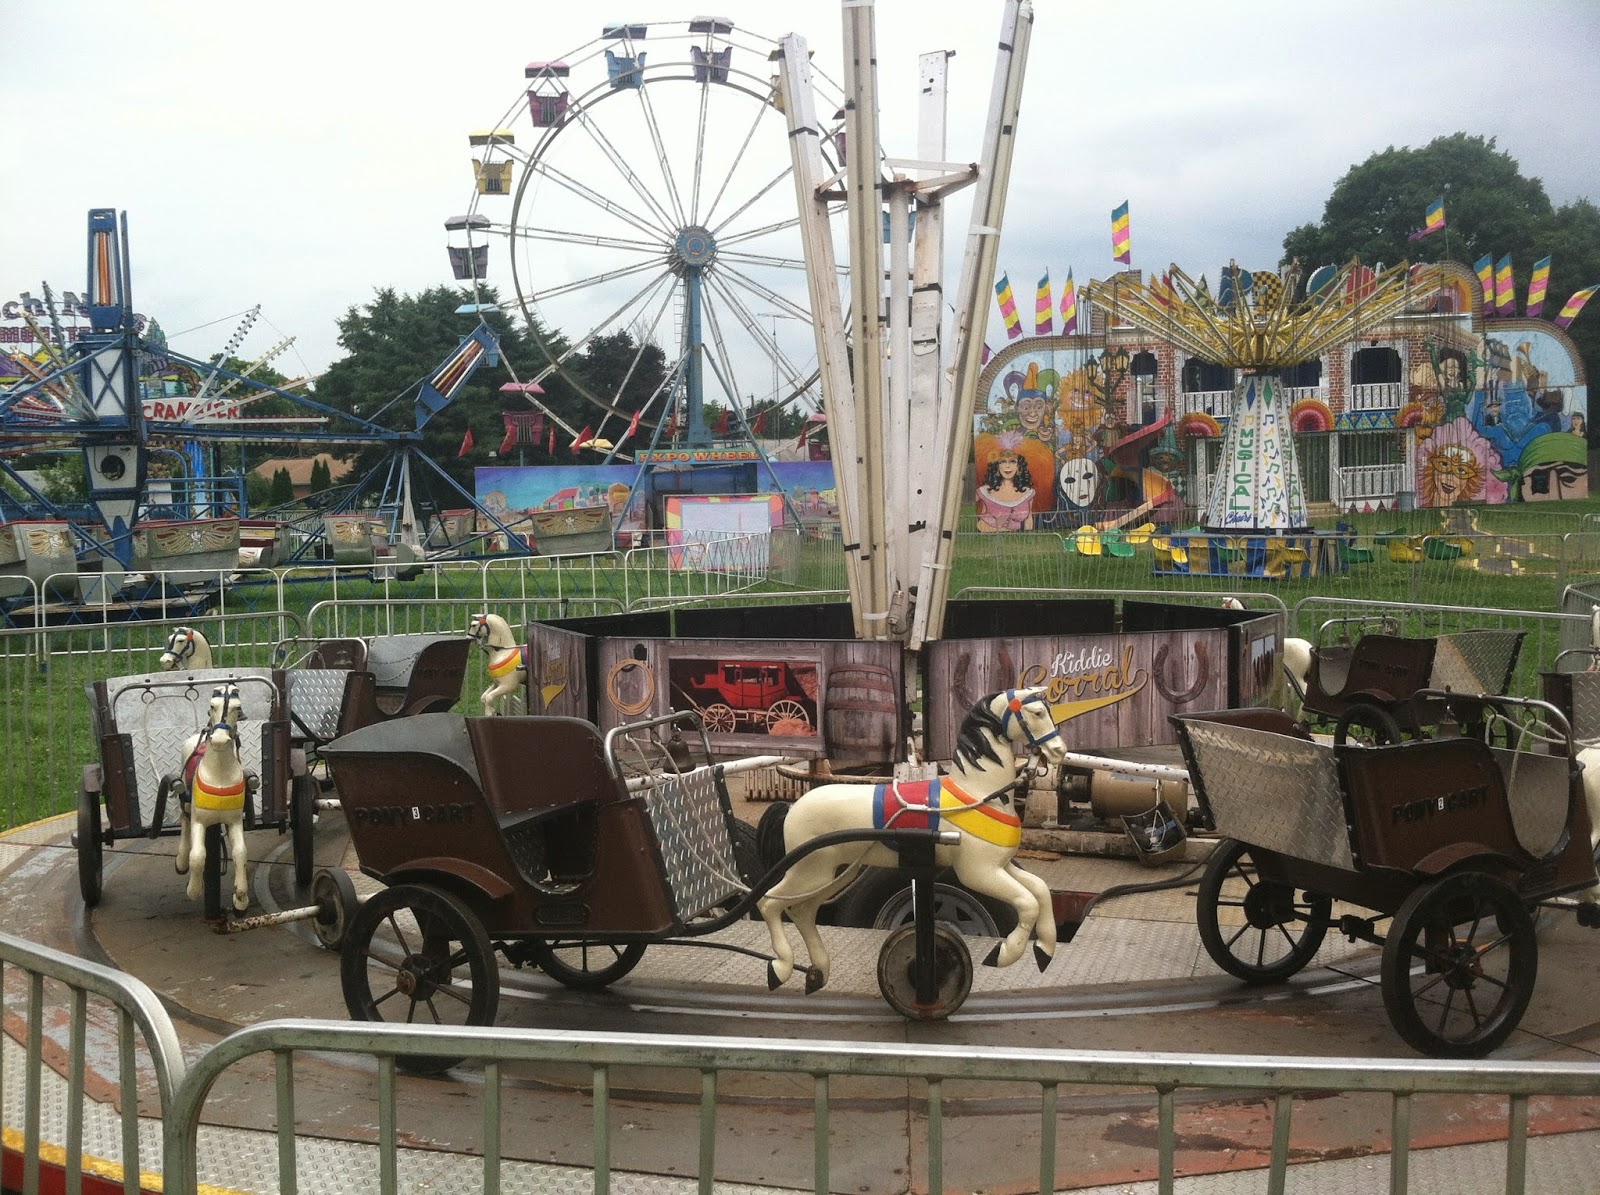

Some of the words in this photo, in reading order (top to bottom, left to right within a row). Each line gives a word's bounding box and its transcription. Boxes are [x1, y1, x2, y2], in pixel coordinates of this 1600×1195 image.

[639, 452, 691, 463] EXPO
[693, 450, 761, 461] WHEEL
[1229, 428, 1254, 511] MUSICAL
[1017, 645, 1149, 703] Corral
[1051, 646, 1114, 677] Kiddie
